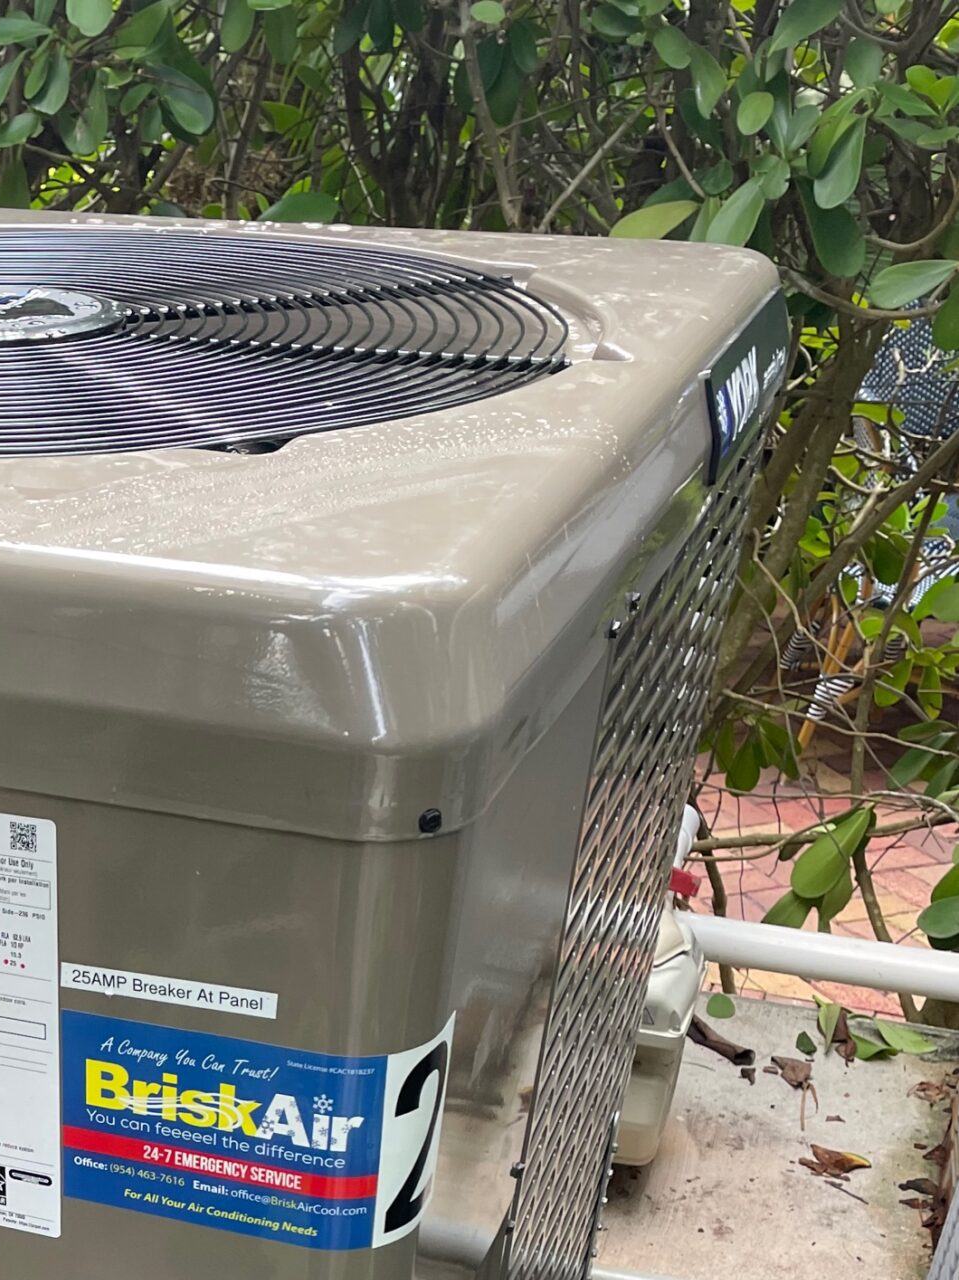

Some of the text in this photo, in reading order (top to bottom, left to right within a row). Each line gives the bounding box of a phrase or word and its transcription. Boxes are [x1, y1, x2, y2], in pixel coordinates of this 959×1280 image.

[8, 857, 19, 867] Use
[20, 859, 34, 870] Only
[72, 969, 263, 1010] 25AMP Breaker At Panel
[100, 1037, 280, 1081] A Company You Can Trust!
[286, 1060, 303, 1070] State
[304, 1063, 328, 1073] License
[86, 1108, 346, 1169] You can feeeeel the difference
[384, 1040, 448, 1234] 2
[73, 1155, 368, 1216] Office: (954) 463-7616 Email: office@BriskAirCool.com
[143, 1145, 303, 1190] 24-7 EMERGENCY SERVICE
[124, 1188, 318, 1237] For All Your Air Conditioning Needs
